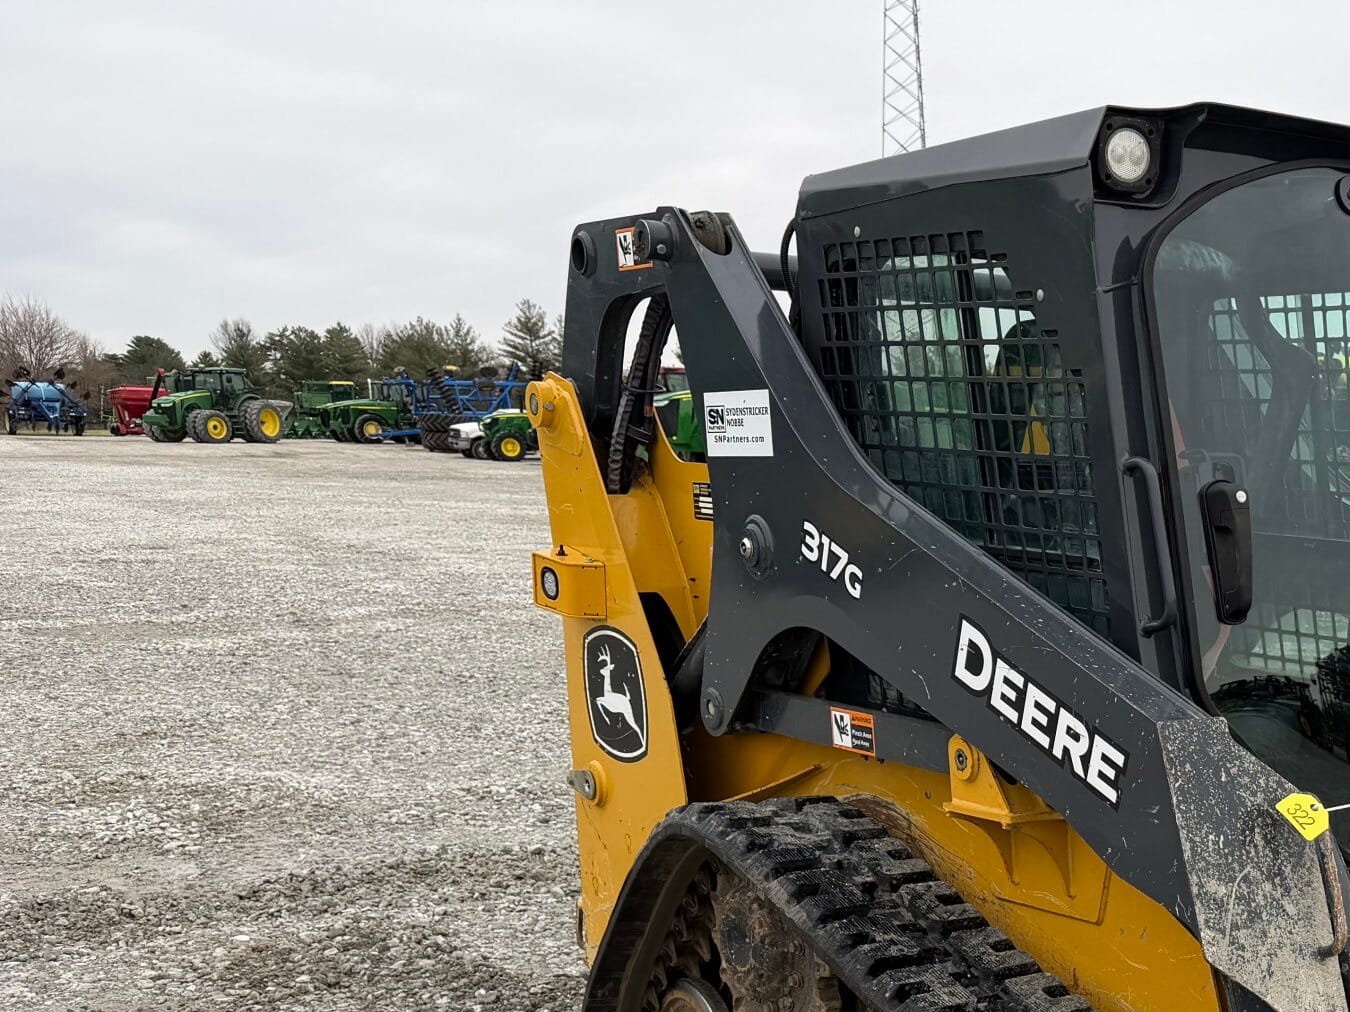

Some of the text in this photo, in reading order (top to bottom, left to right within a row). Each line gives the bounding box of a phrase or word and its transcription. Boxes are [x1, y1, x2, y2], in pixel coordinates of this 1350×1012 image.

[708, 408, 725, 425] SN
[725, 406, 768, 416] SYDENSTRICKER
[714, 434, 765, 443] SNPartners.com
[801, 520, 863, 599] 317G
[954, 618, 1126, 804] DEERE
[1286, 803, 1315, 830] 322
